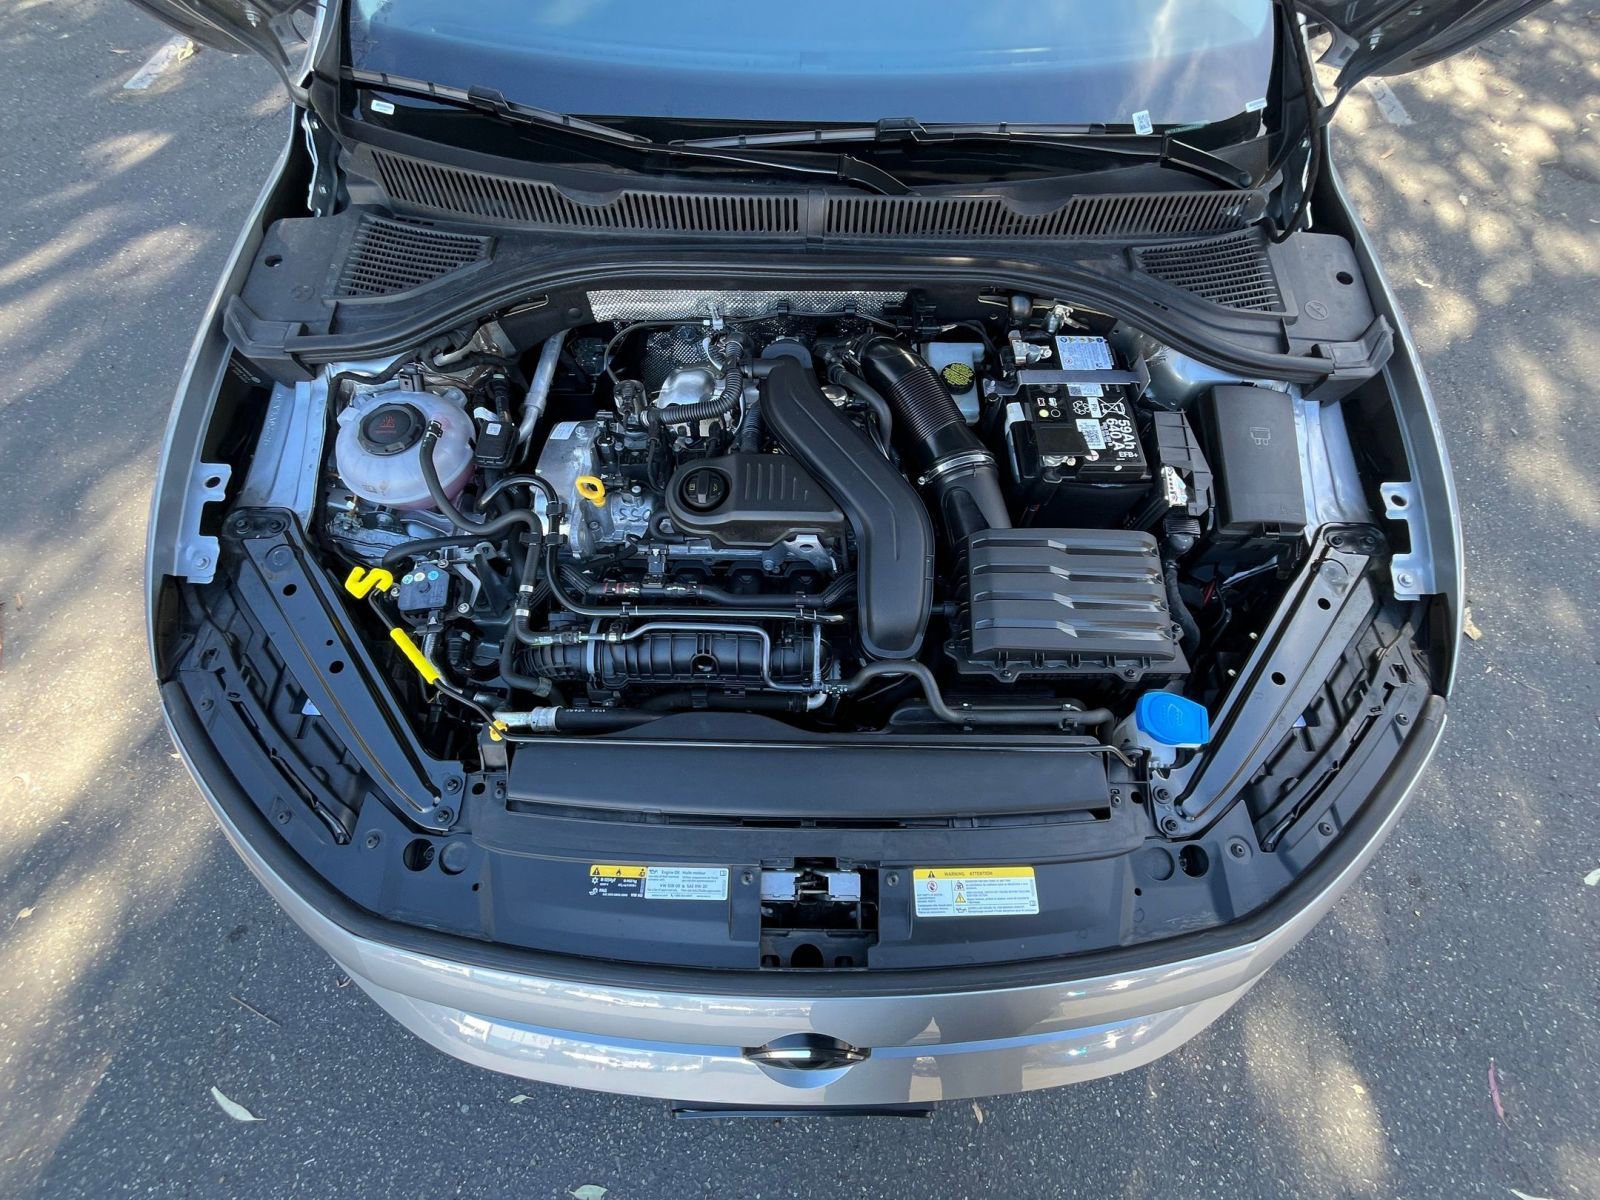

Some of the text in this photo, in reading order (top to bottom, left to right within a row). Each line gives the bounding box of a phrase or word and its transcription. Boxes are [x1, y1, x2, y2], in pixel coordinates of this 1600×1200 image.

[1106, 418, 1122, 439] 640
[1118, 420, 1136, 449] 59Ah
[1112, 441, 1125, 450] A
